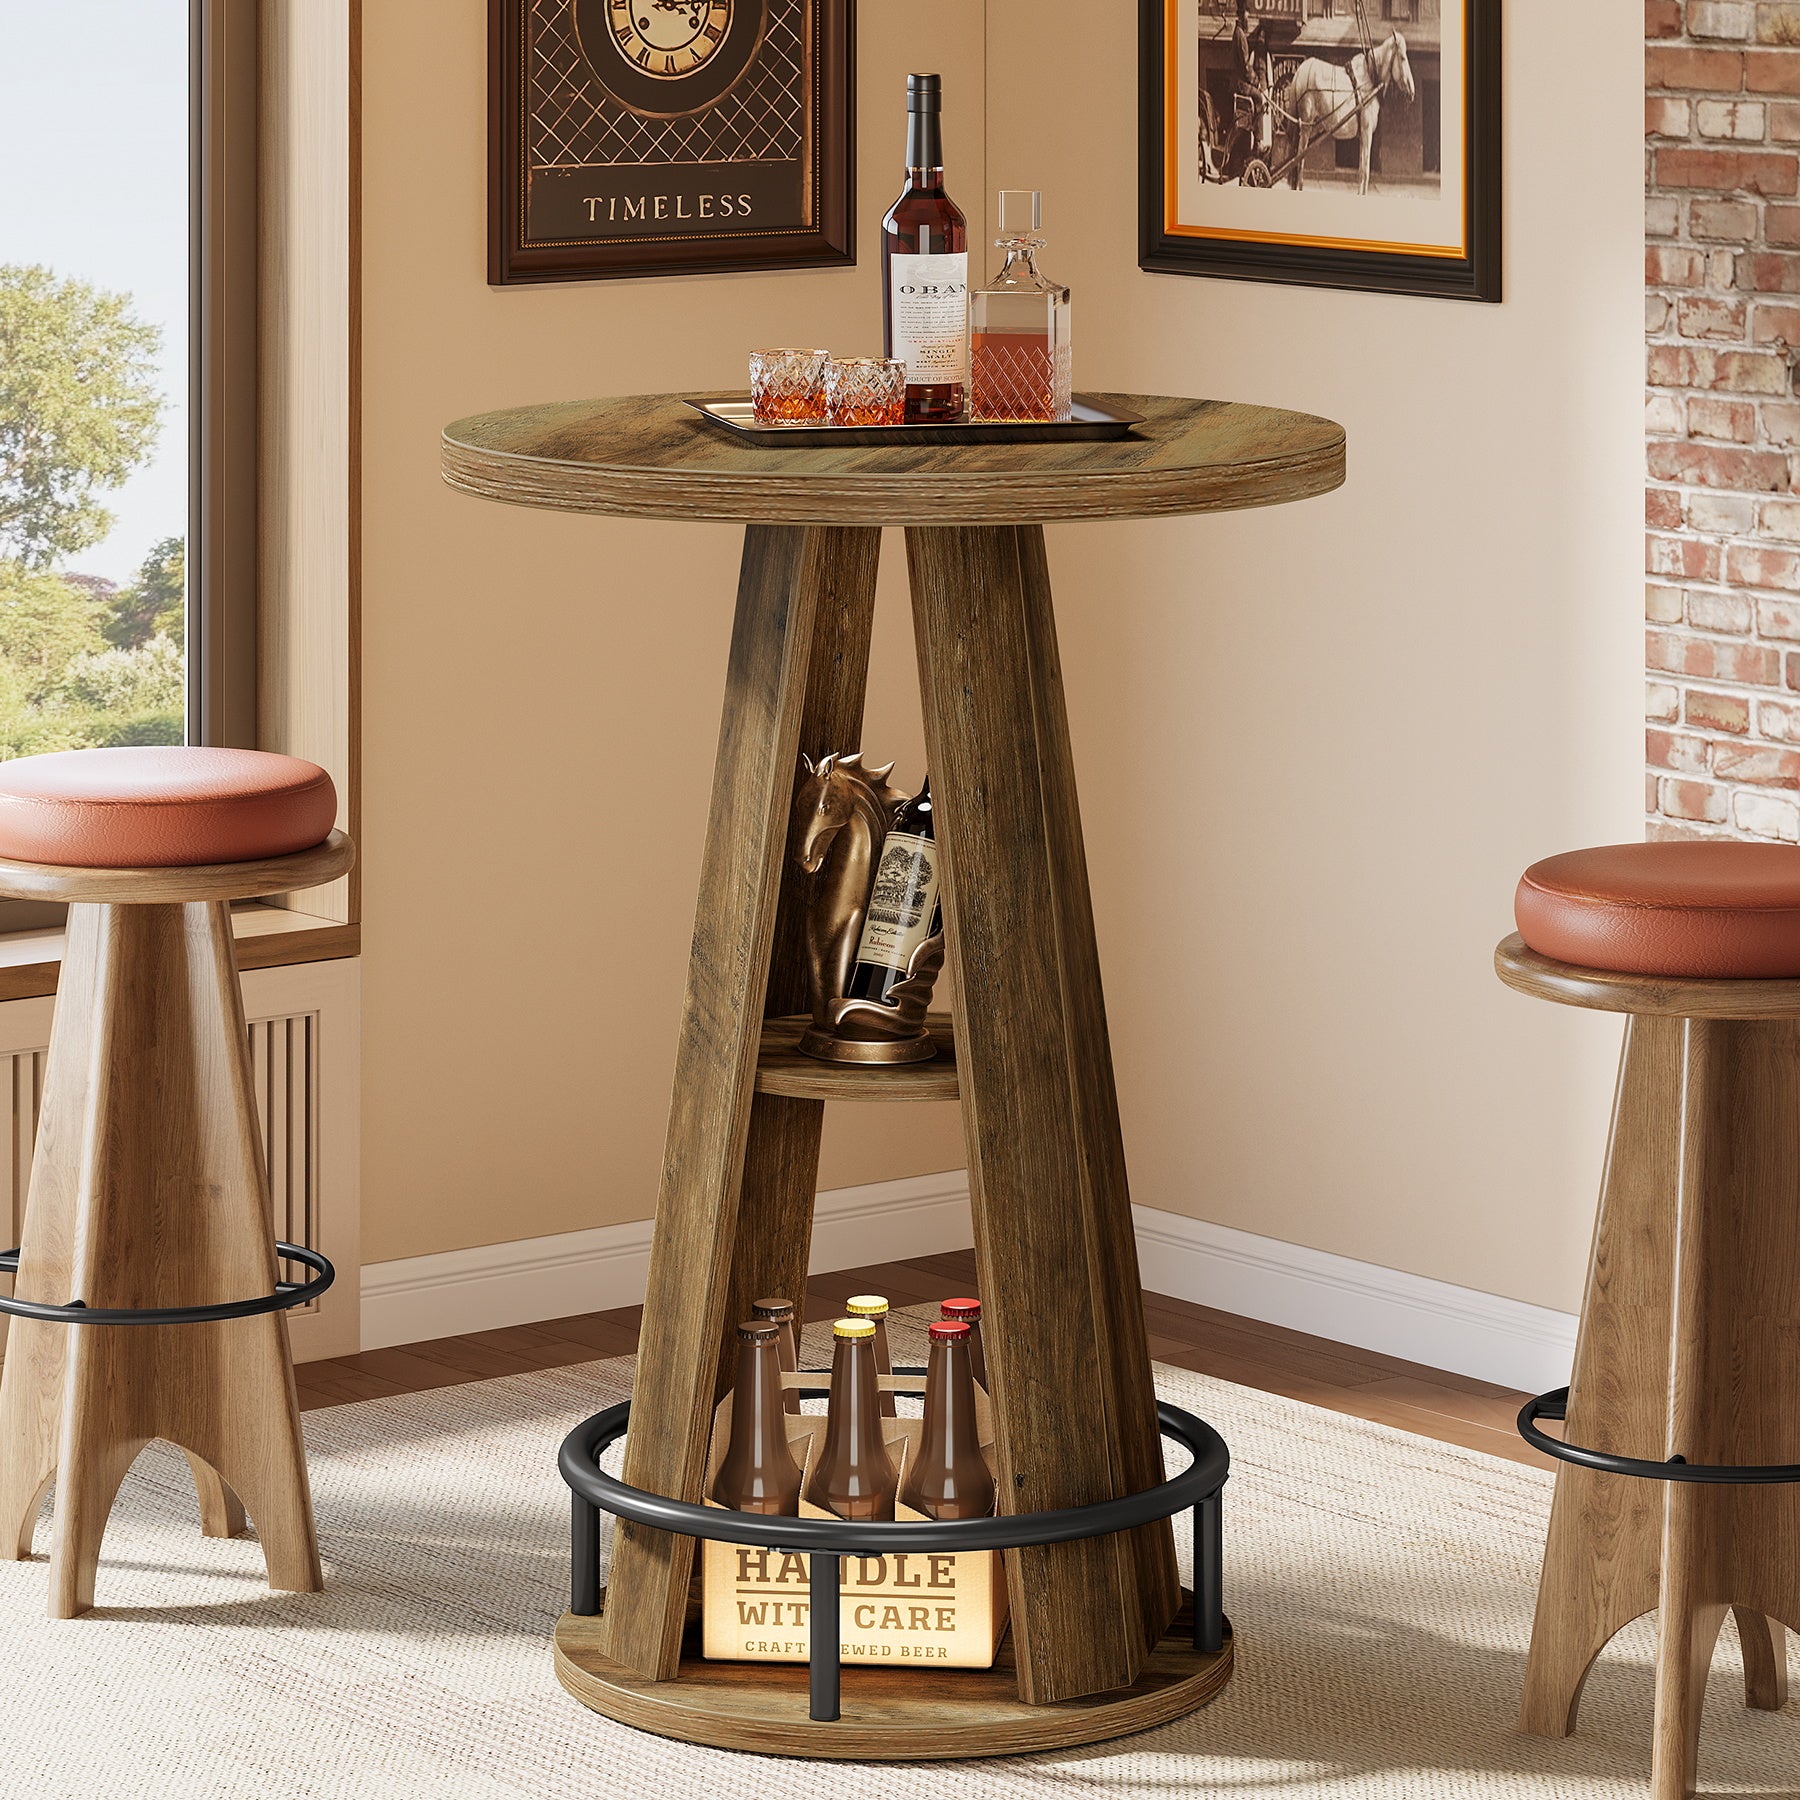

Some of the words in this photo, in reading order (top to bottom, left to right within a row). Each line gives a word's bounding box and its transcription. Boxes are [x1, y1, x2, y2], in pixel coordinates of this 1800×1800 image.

[582, 194, 753, 222] TIMELESS
[736, 1601, 809, 1627] WIT
[854, 1604, 956, 1632] CARE
[745, 1640, 806, 1654] CRAFT
[841, 1643, 892, 1657] EWED
[900, 1646, 948, 1659] BEER
